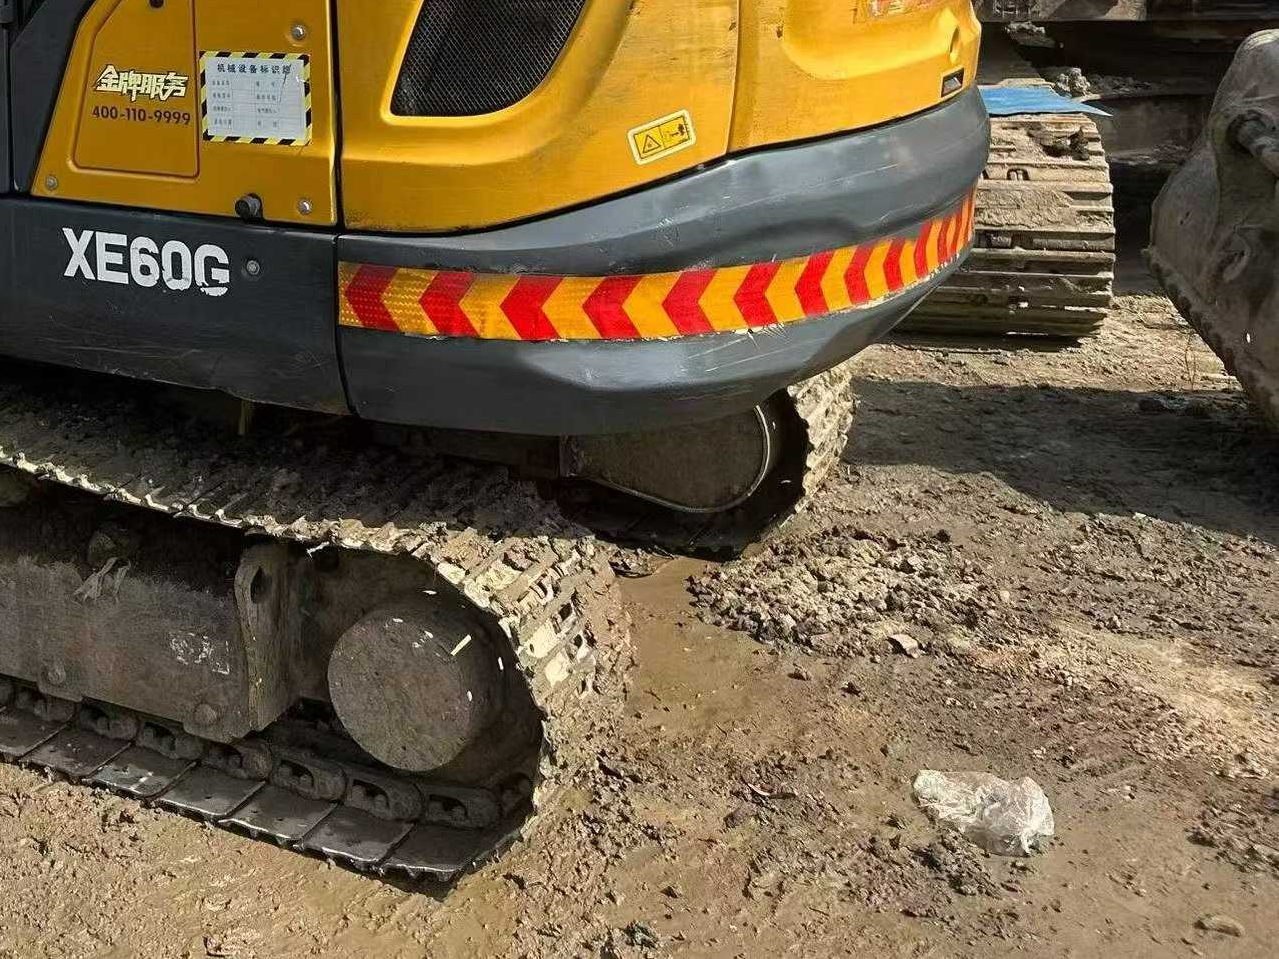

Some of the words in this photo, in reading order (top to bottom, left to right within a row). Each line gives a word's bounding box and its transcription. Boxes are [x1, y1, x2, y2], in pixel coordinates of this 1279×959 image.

[95, 64, 189, 102] 金牌服务
[92, 105, 191, 125] 400-110-9999
[62, 227, 230, 297] XE60G
